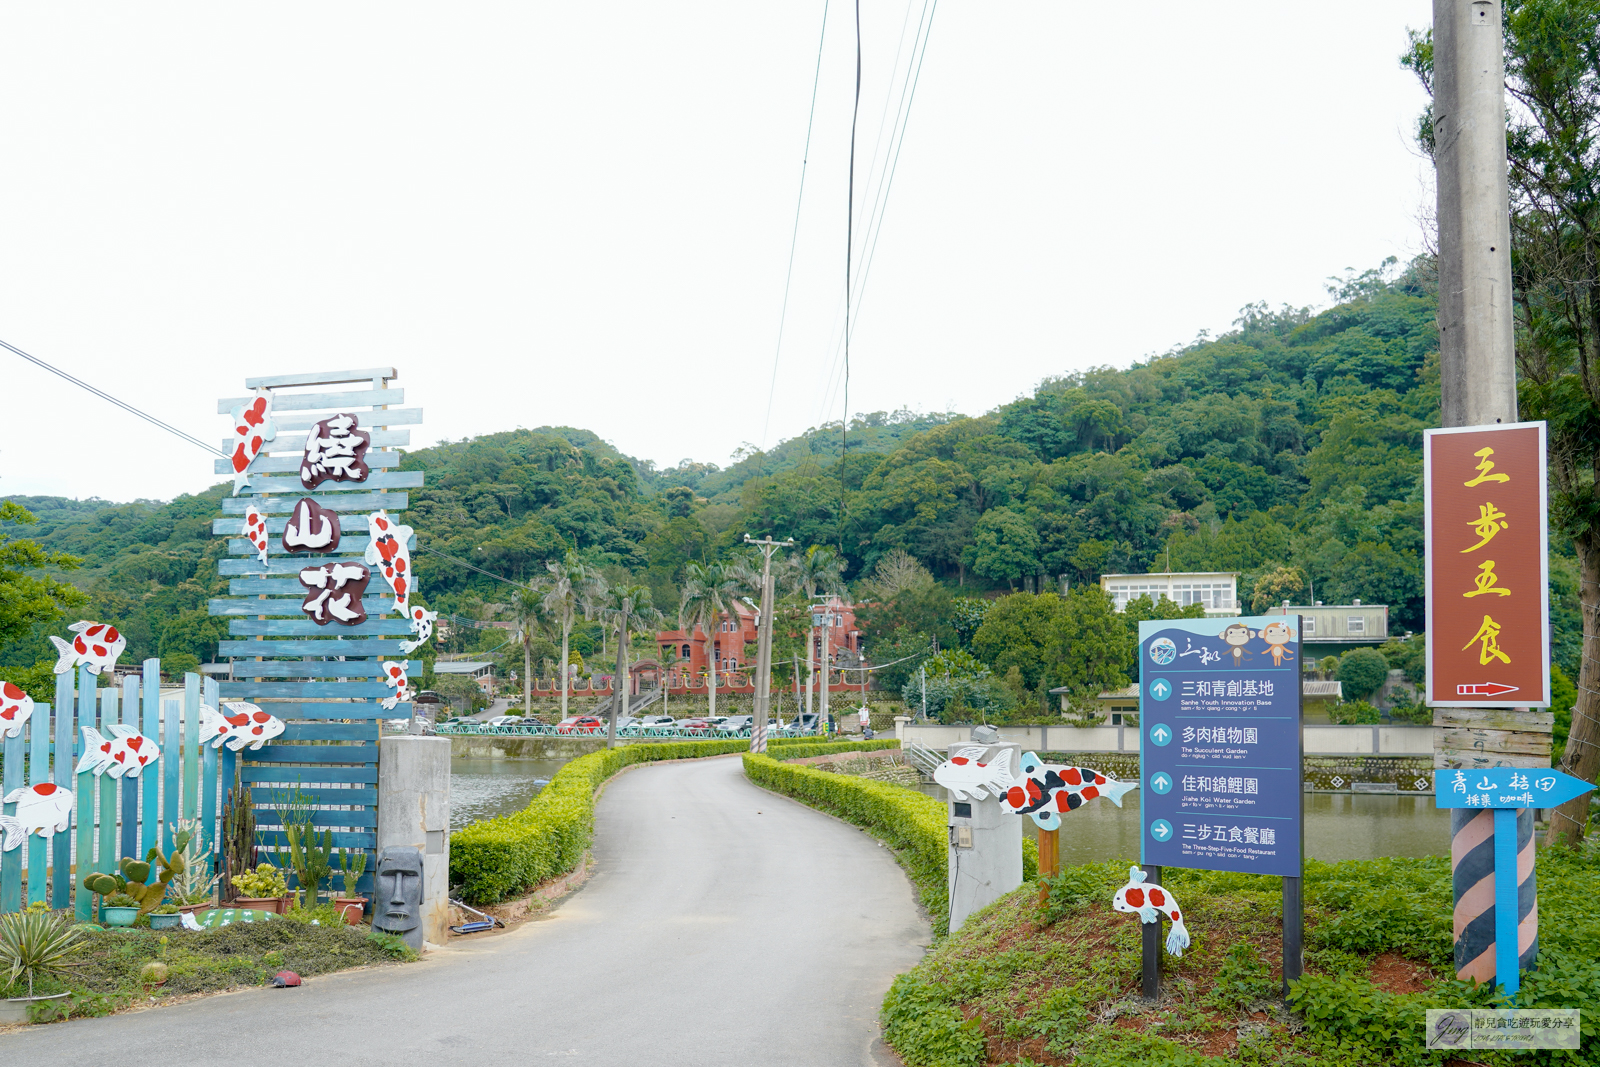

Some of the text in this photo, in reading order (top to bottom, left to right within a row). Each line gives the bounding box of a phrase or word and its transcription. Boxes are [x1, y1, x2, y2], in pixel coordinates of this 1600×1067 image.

[1458, 446, 1512, 666] 三步五食
[1179, 637, 1221, 665] 三和
[1181, 680, 1274, 697] 三和青創基地
[1182, 726, 1258, 745] 多肉植物園
[1182, 775, 1258, 795] 佳和錦鯉園
[1182, 824, 1276, 845] 三步五食餐廳
